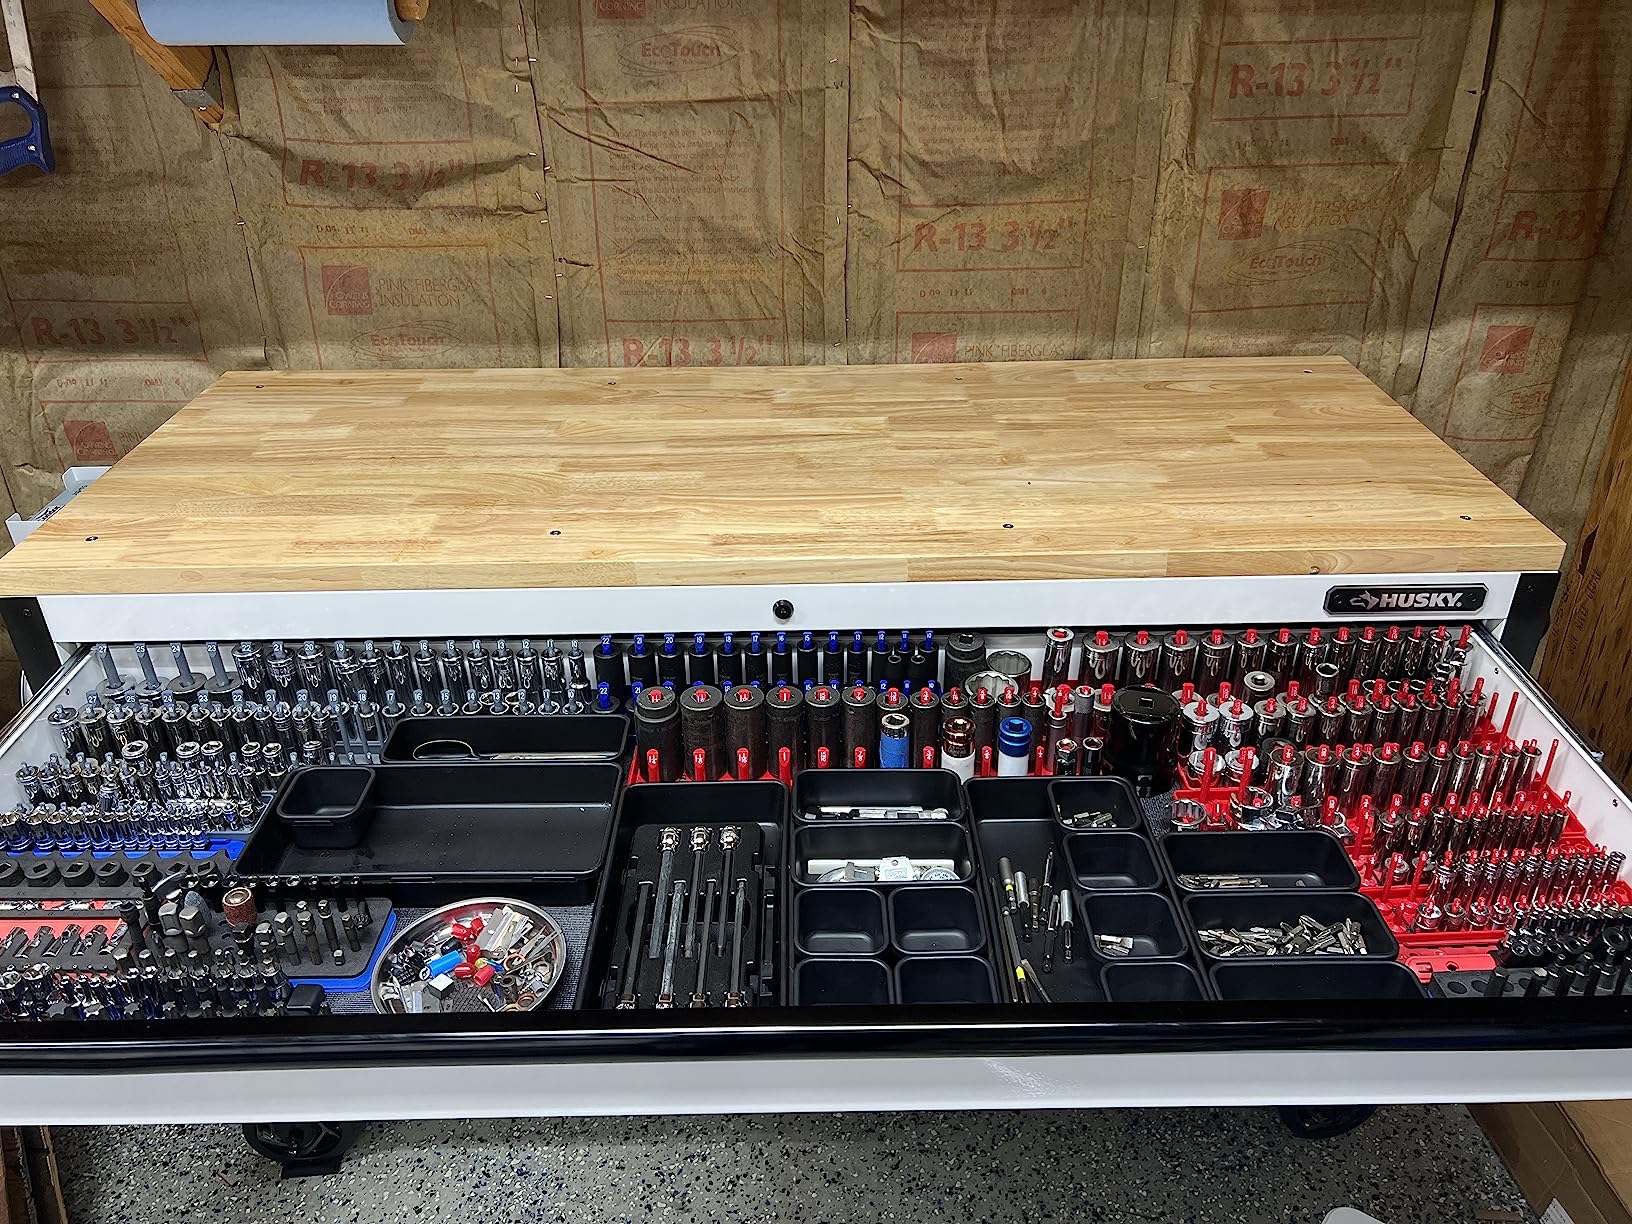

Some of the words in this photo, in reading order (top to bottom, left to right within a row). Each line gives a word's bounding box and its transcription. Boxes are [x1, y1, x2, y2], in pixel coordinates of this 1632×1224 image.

[641, 42, 721, 58] EcoTouch
[1229, 63, 1308, 99] R-13
[300, 159, 378, 189] R-13
[914, 222, 987, 252] R-13
[378, 278, 409, 291] PINK
[378, 294, 461, 307] INSULATION
[31, 317, 106, 345] R-13
[370, 334, 447, 348] EcoTouch
[623, 337, 692, 367] R-13
[964, 345, 993, 357] PINK
[1001, 344, 1065, 357] FIBERGLAS
